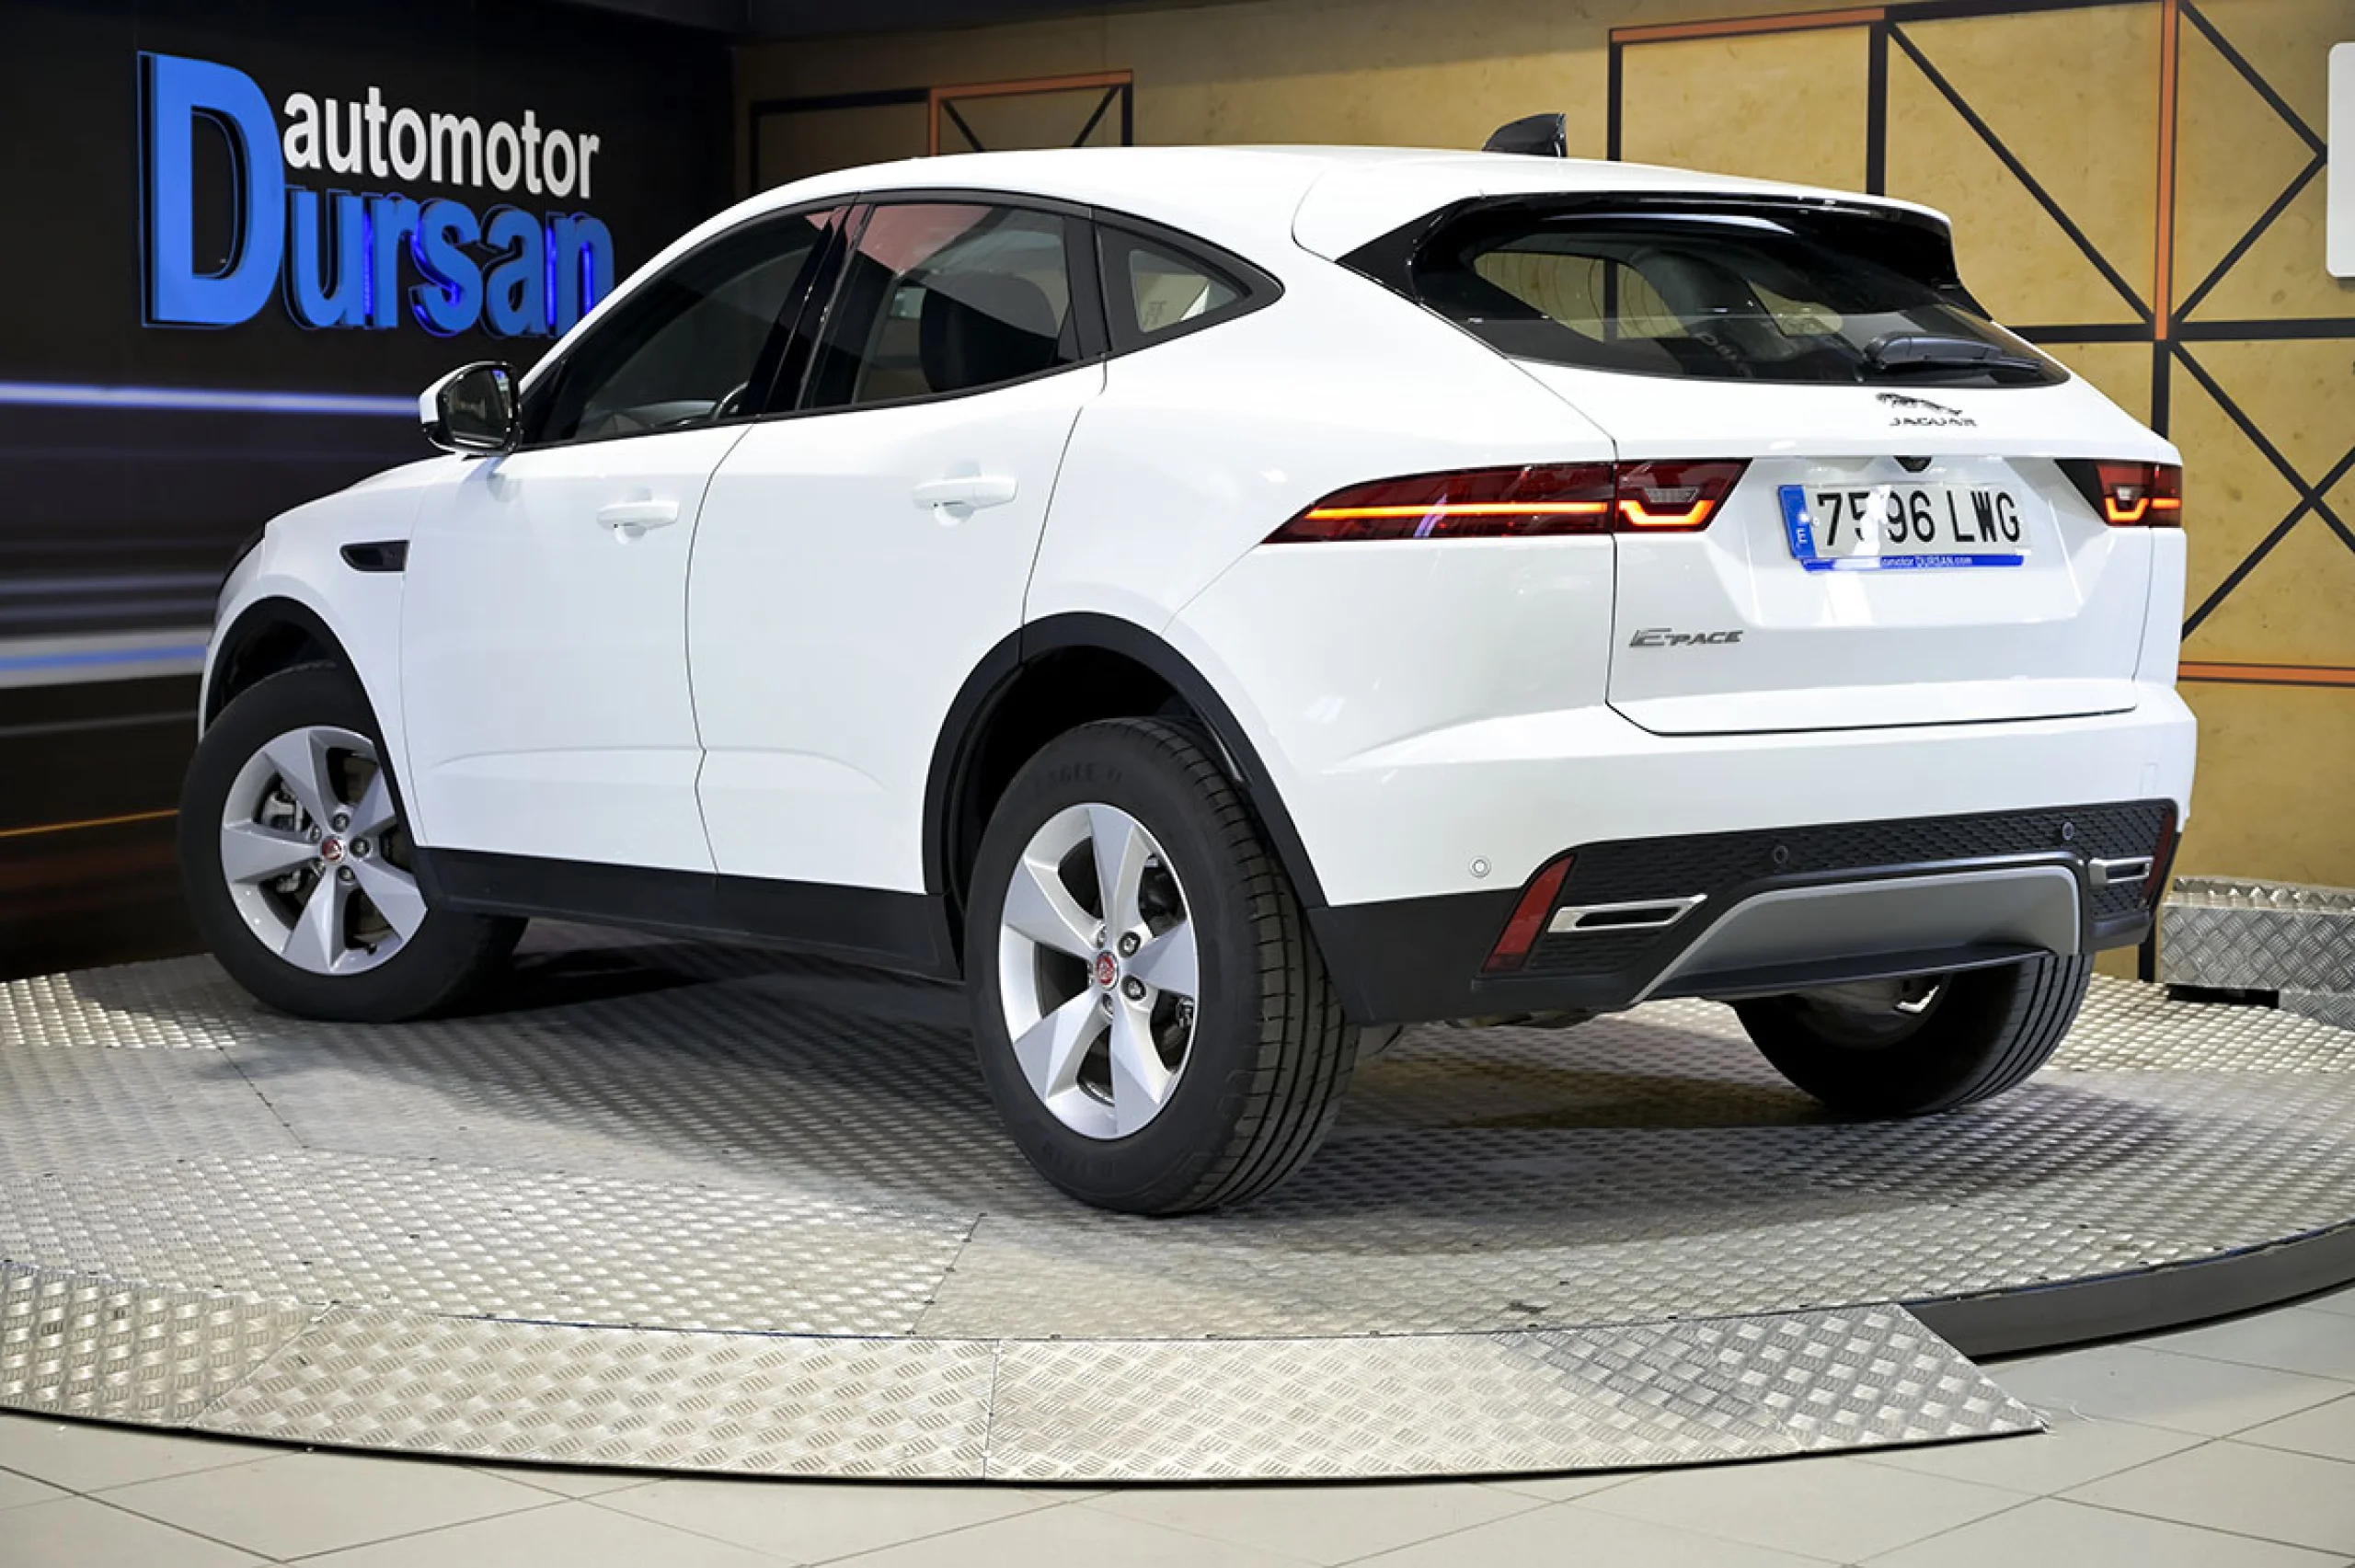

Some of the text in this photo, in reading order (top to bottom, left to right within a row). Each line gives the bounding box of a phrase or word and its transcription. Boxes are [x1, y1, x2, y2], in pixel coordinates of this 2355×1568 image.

[283, 86, 601, 200] automotor
[138, 51, 615, 338] Dursan
[1890, 417, 1977, 427] JAGUAR
[1796, 528, 1809, 544] E
[1817, 490, 2019, 545] 7596 LWG
